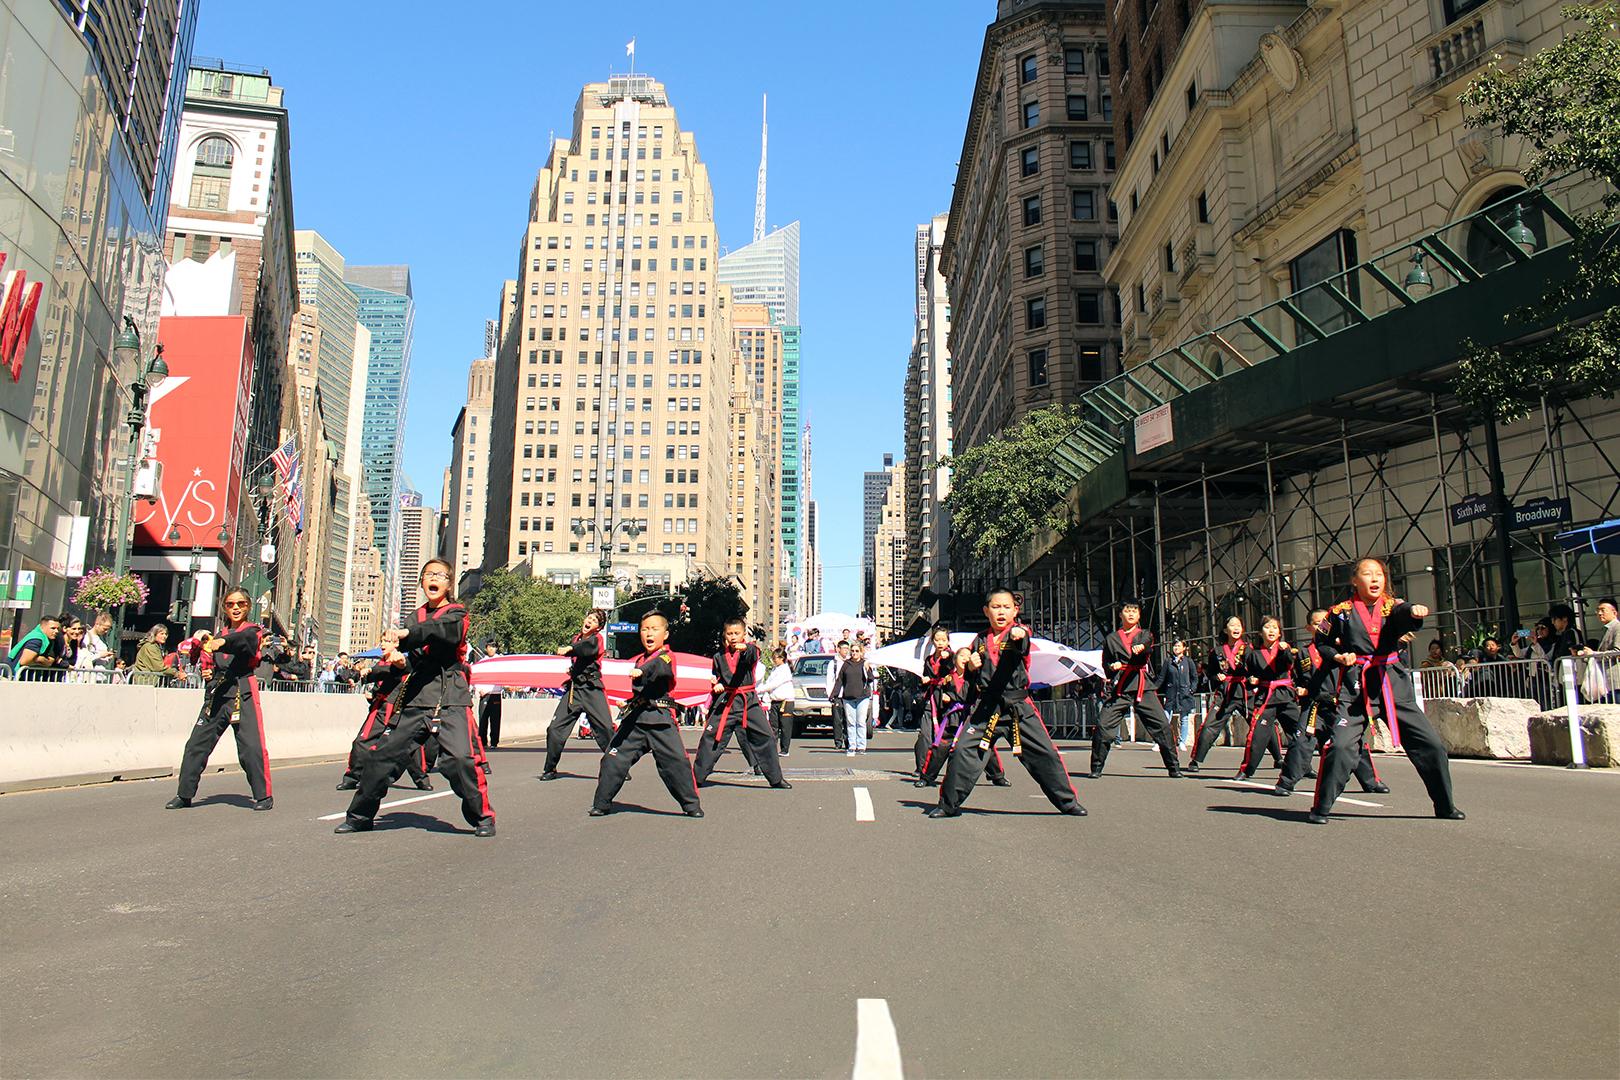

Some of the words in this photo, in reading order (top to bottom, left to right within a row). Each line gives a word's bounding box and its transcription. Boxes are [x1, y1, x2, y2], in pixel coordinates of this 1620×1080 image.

[1156, 406, 1169, 418] STREET
[1456, 504, 1473, 519] Sixth
[1473, 502, 1487, 514] Ave
[1515, 506, 1562, 523] Broadway
[598, 590, 609, 598] NO
